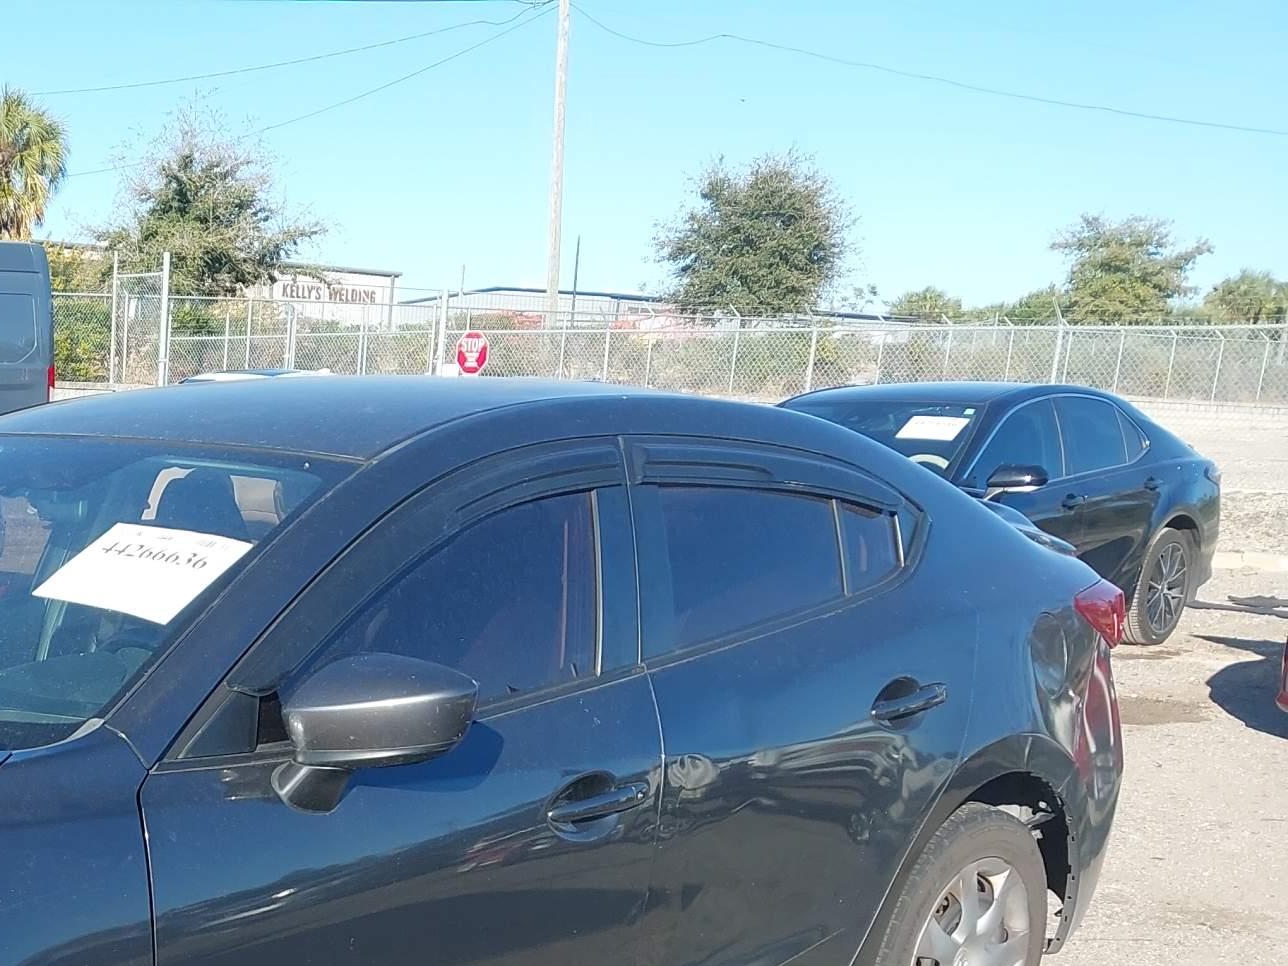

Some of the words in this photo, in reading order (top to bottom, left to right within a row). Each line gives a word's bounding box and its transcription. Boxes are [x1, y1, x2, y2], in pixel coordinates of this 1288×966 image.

[281, 282, 323, 301] KELLY'S
[328, 286, 377, 304] WELDING
[461, 337, 486, 353] STOP
[102, 541, 208, 570] 44266636
